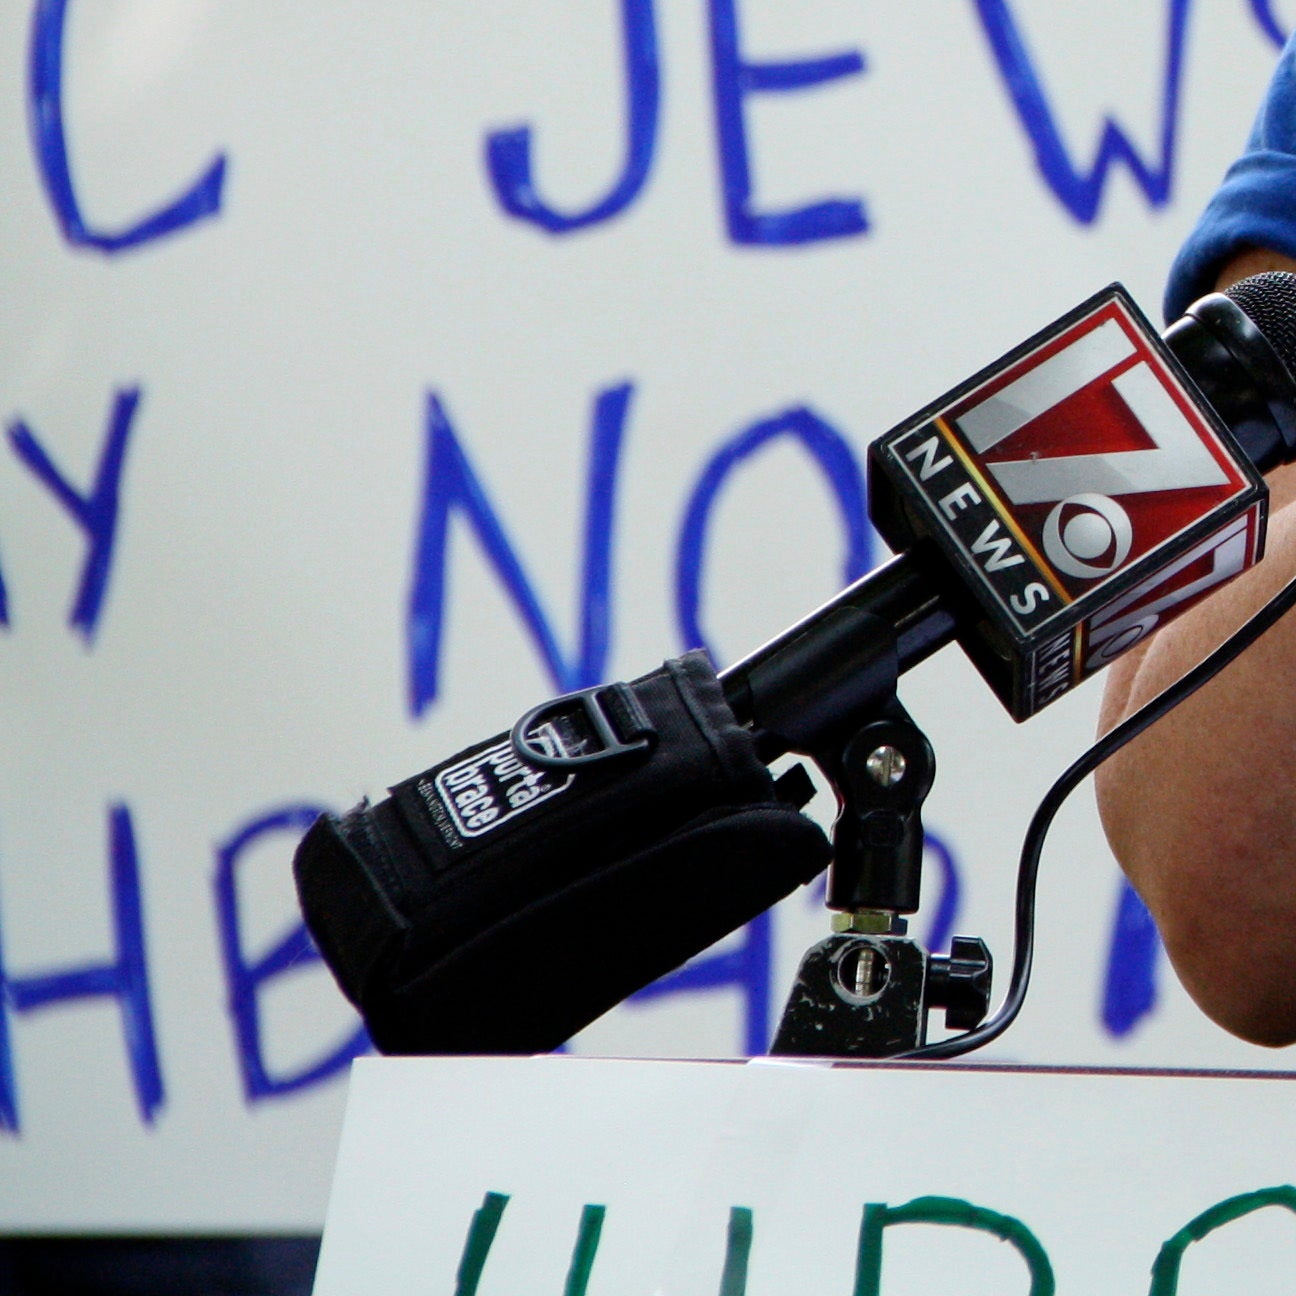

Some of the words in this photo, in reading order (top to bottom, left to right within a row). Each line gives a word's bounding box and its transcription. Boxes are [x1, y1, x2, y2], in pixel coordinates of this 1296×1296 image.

[0, 381, 143, 645] Y
[905, 435, 1051, 616] NEWS
[442, 763, 500, 829] brace
